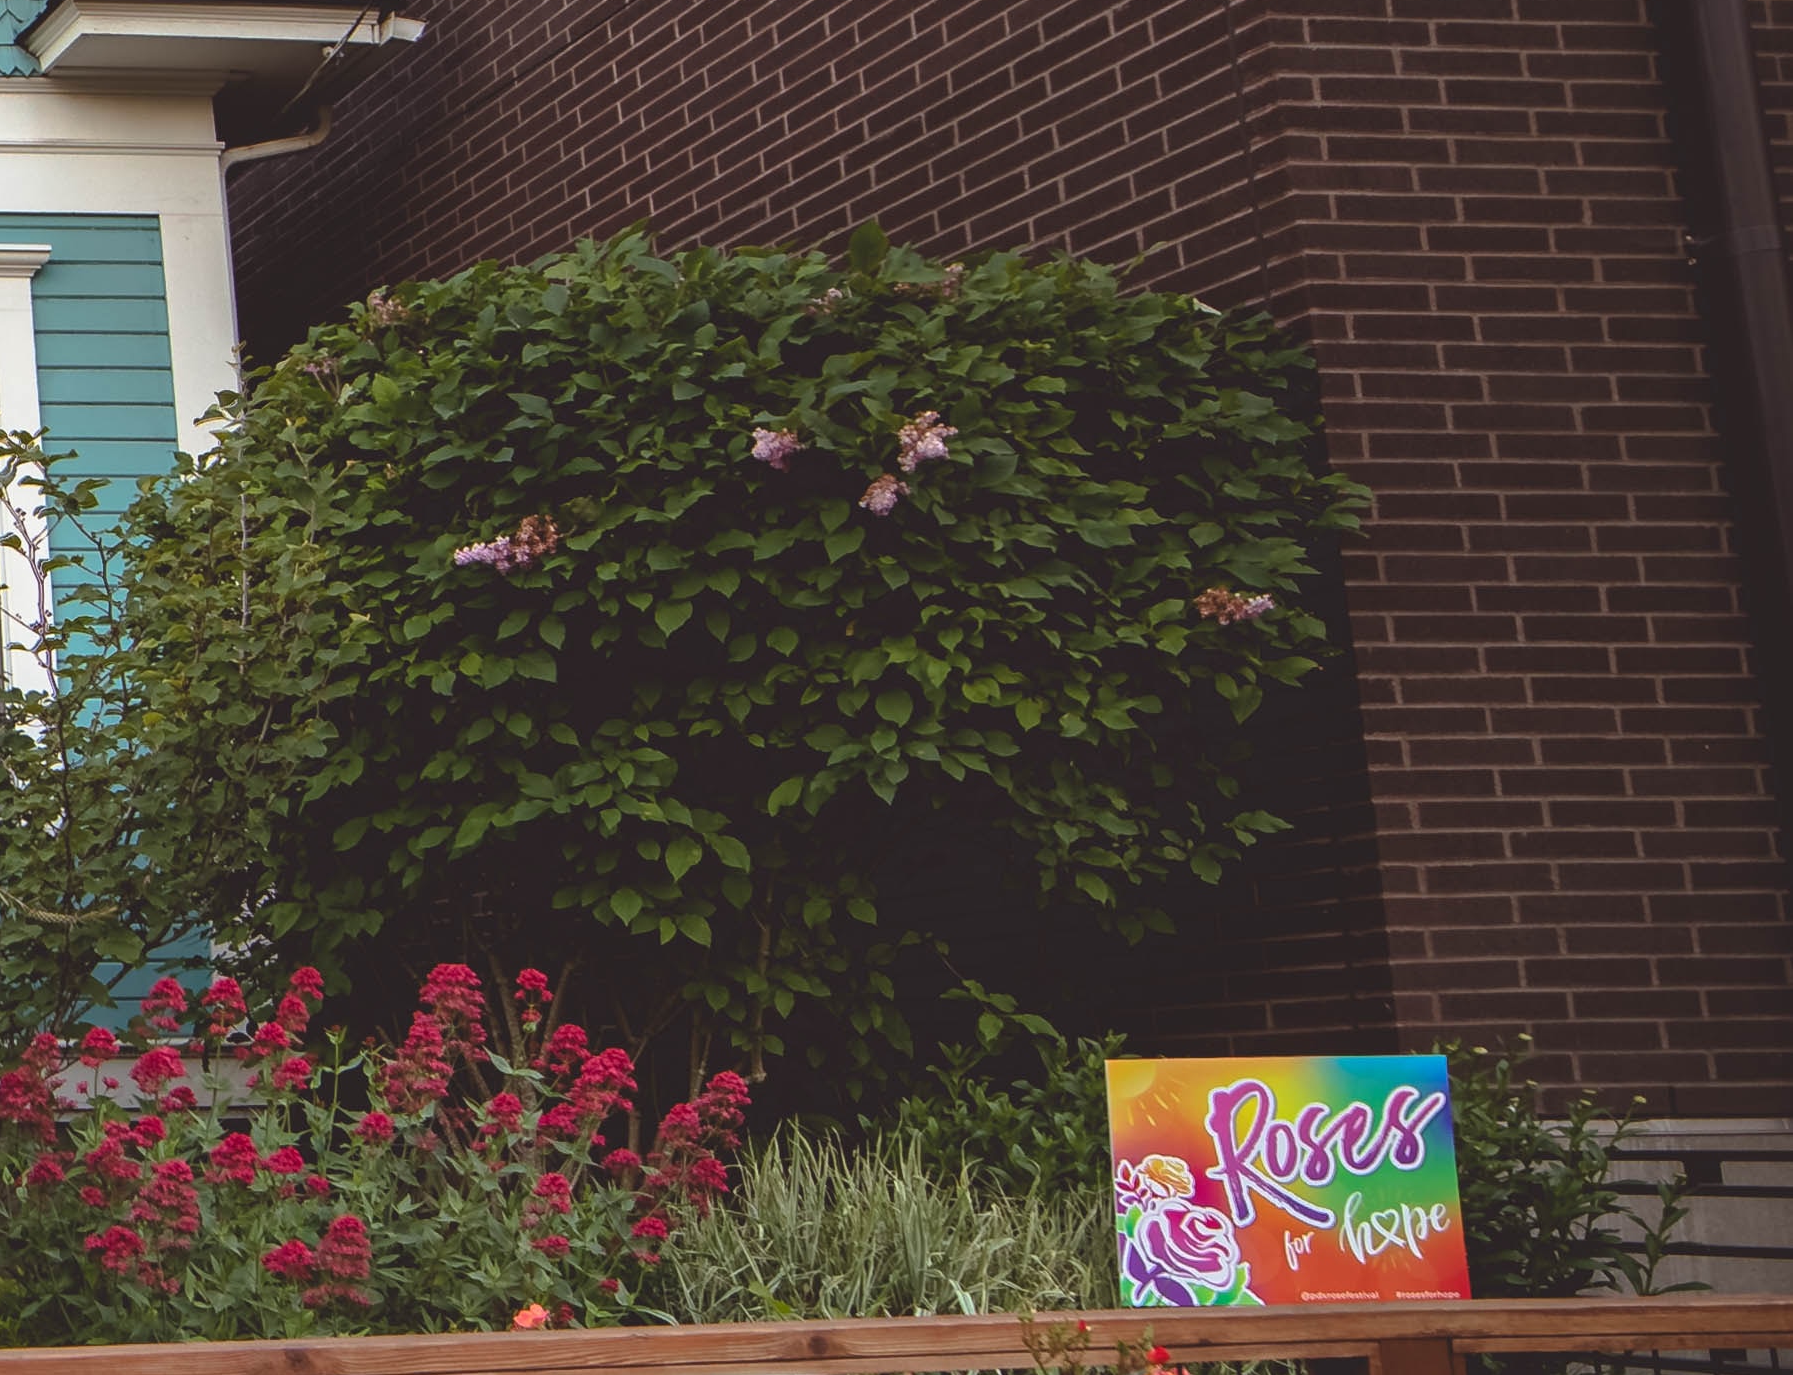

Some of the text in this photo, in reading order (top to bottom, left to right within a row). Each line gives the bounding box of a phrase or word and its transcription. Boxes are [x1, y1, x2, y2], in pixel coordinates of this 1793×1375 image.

[1205, 1078, 1446, 1229] Roses
[1283, 1191, 1451, 1271] for hope
